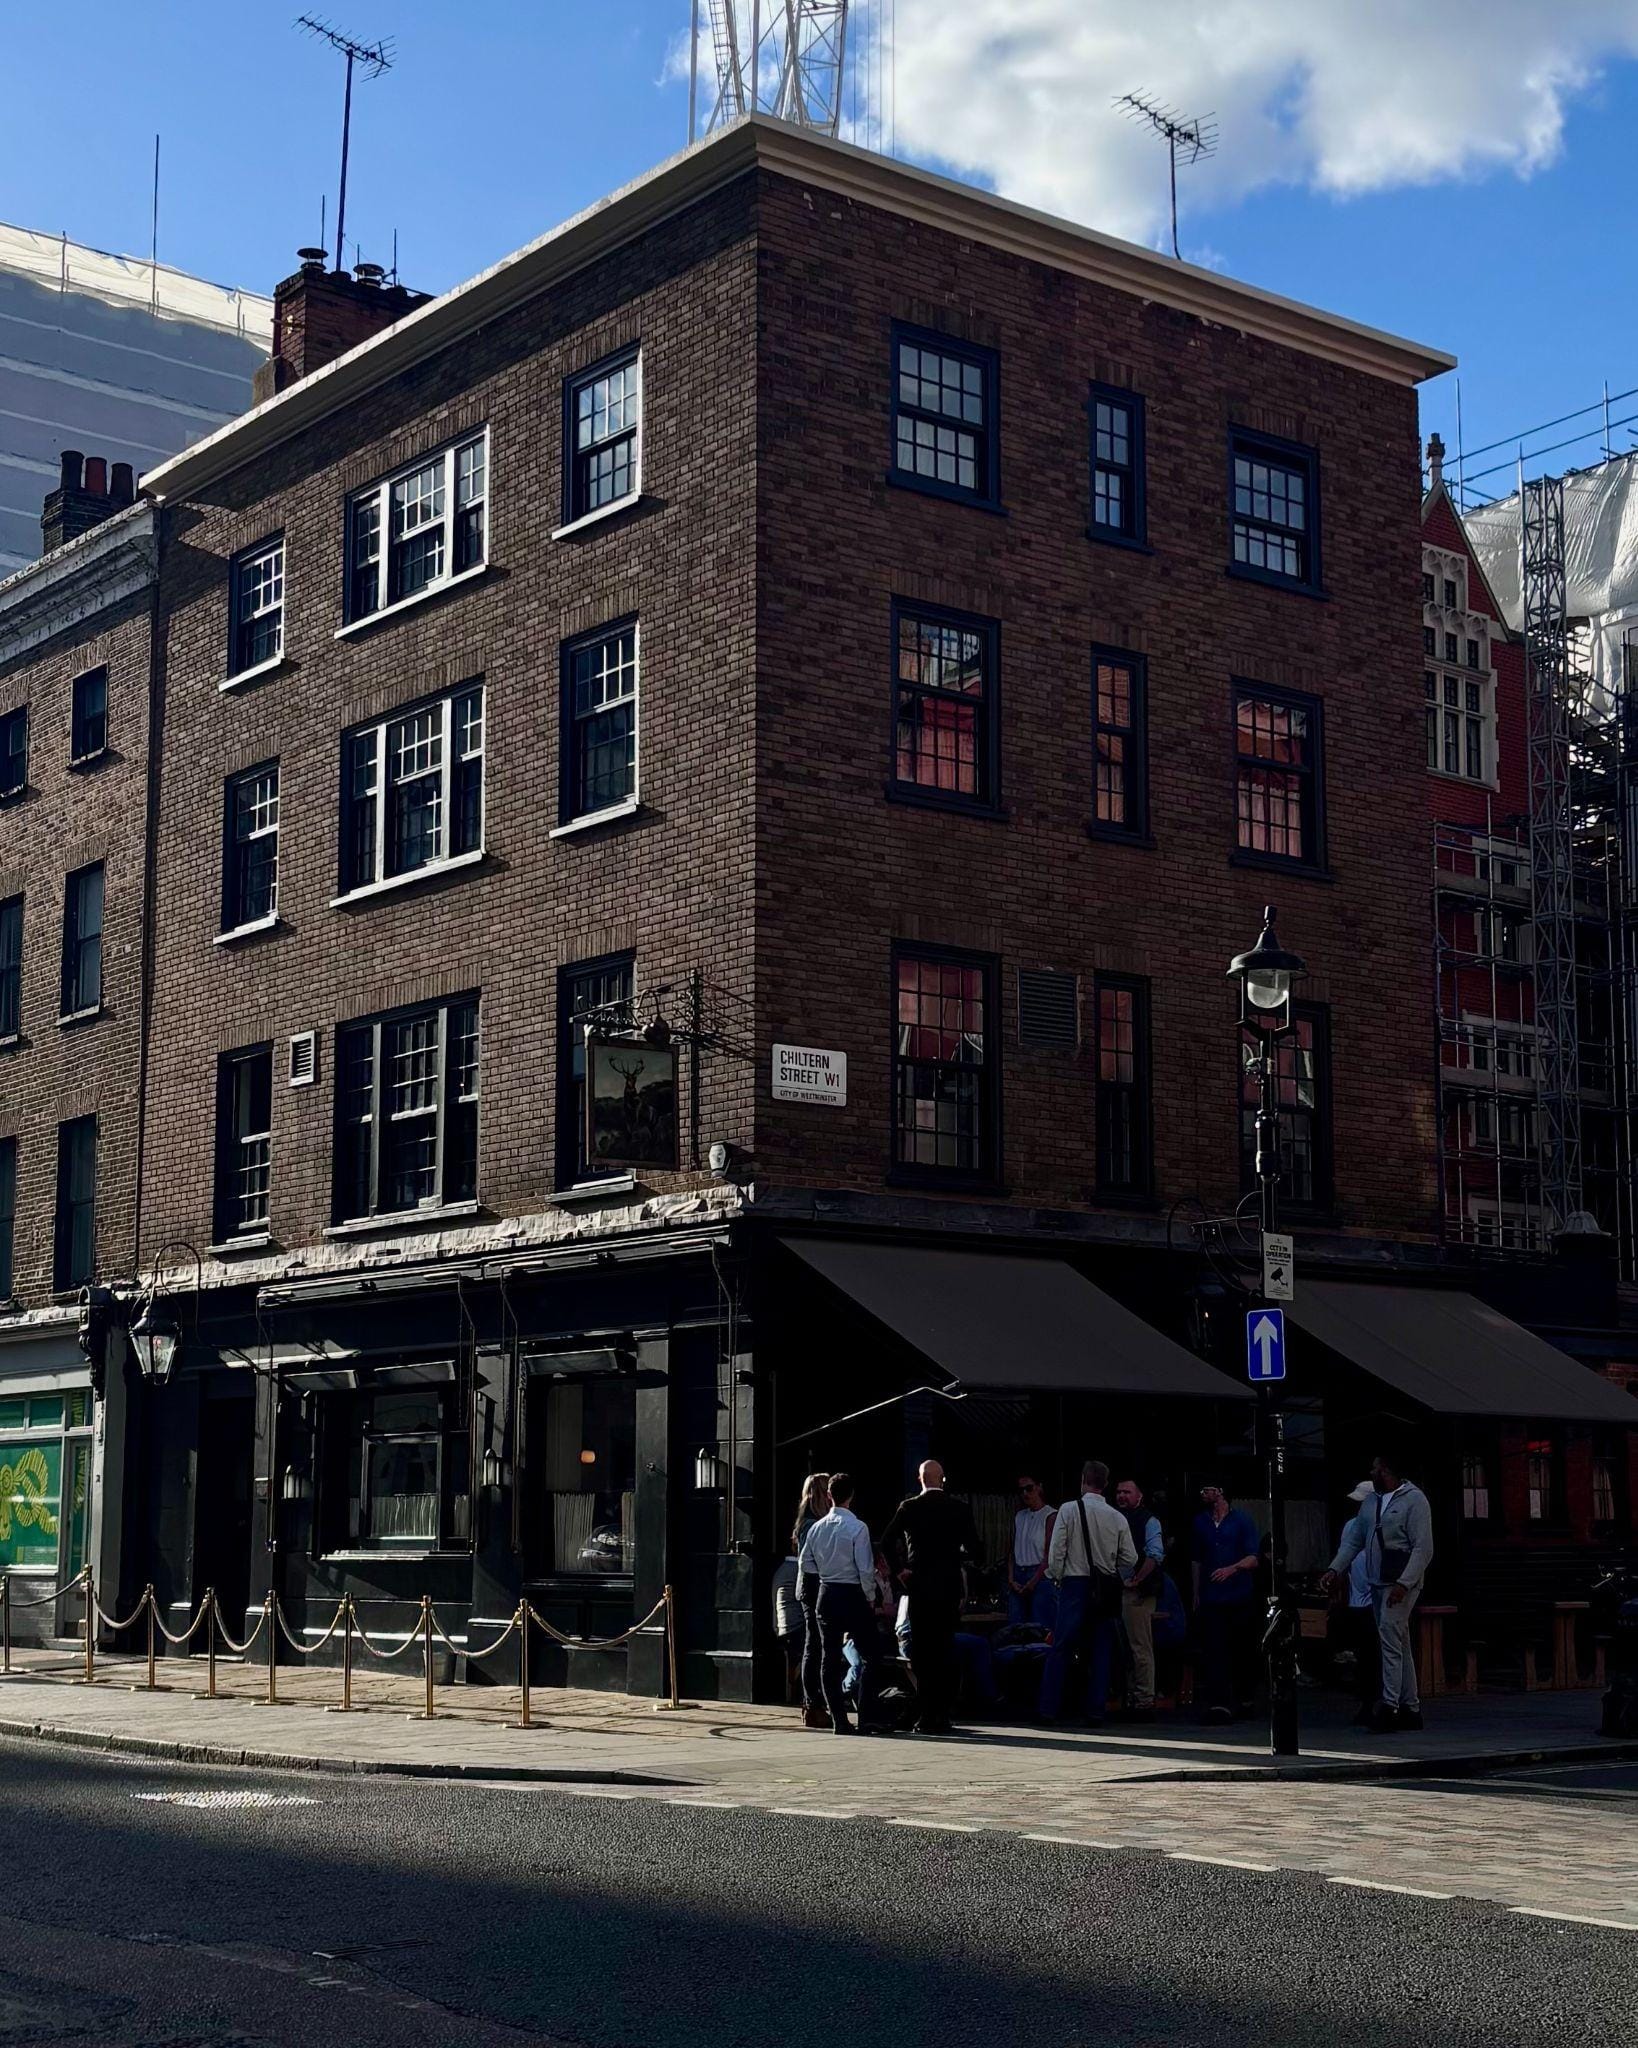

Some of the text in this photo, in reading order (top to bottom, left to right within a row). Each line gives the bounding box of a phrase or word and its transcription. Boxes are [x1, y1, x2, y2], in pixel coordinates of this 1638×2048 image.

[780, 1051, 829, 1069] CHILTERN
[780, 1068, 840, 1087] STREET W1
[801, 1092, 836, 1102] WESTMINSTER
